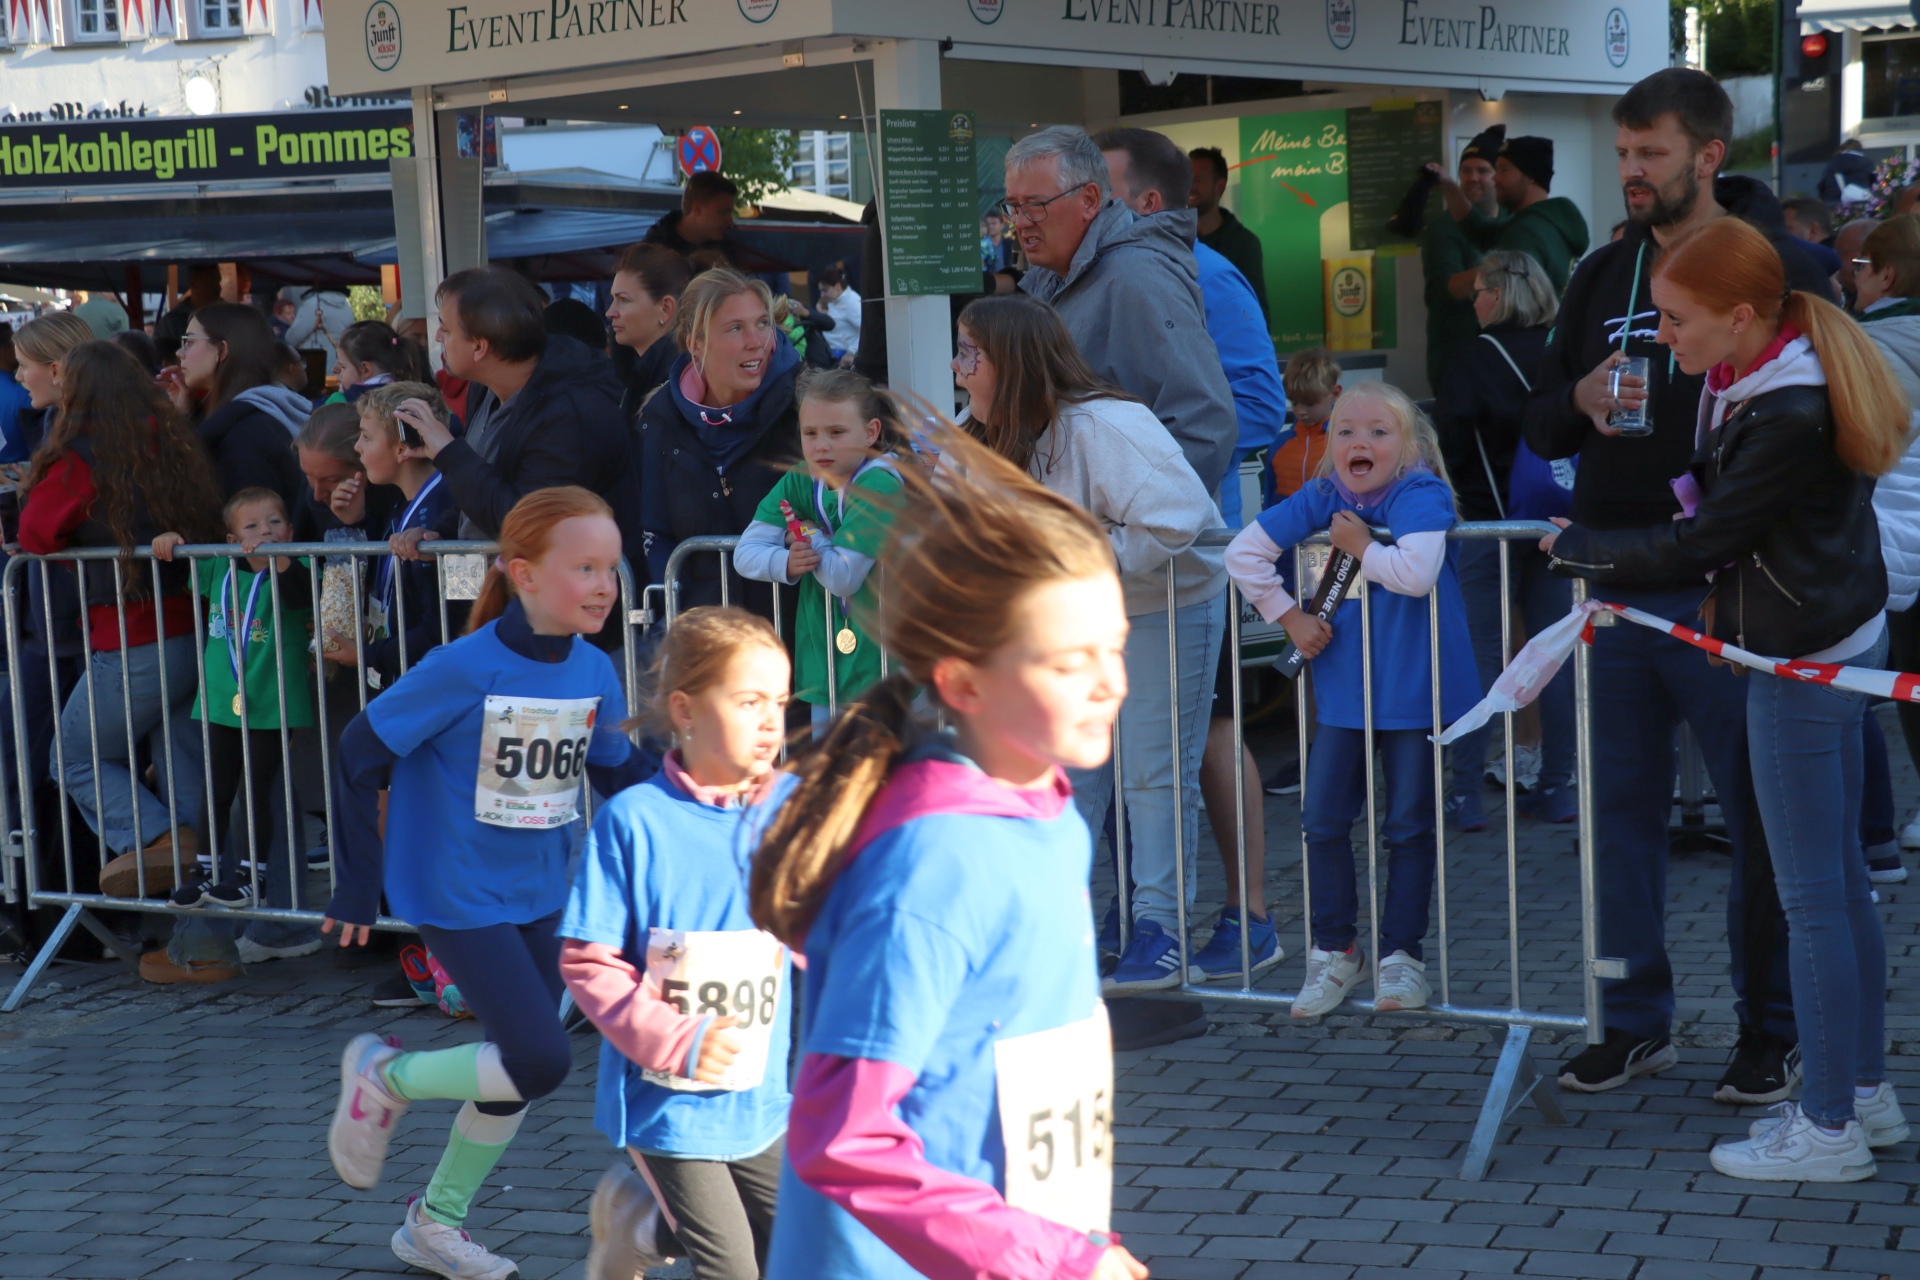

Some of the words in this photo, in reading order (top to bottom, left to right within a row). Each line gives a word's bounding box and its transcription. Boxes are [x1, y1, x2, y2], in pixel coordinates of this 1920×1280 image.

[886, 118, 917, 128] Preisliste
[0, 127, 218, 180] Holzkohlegrill
[256, 124, 411, 166] Pommes
[1250, 128, 1312, 153] Meine
[1271, 160, 1322, 179] mein
[1322, 581, 1342, 613] NEUE
[495, 737, 587, 780] 5066
[483, 811, 504, 821] AOK
[516, 815, 546, 825] VOSS
[661, 975, 777, 1030] 5898
